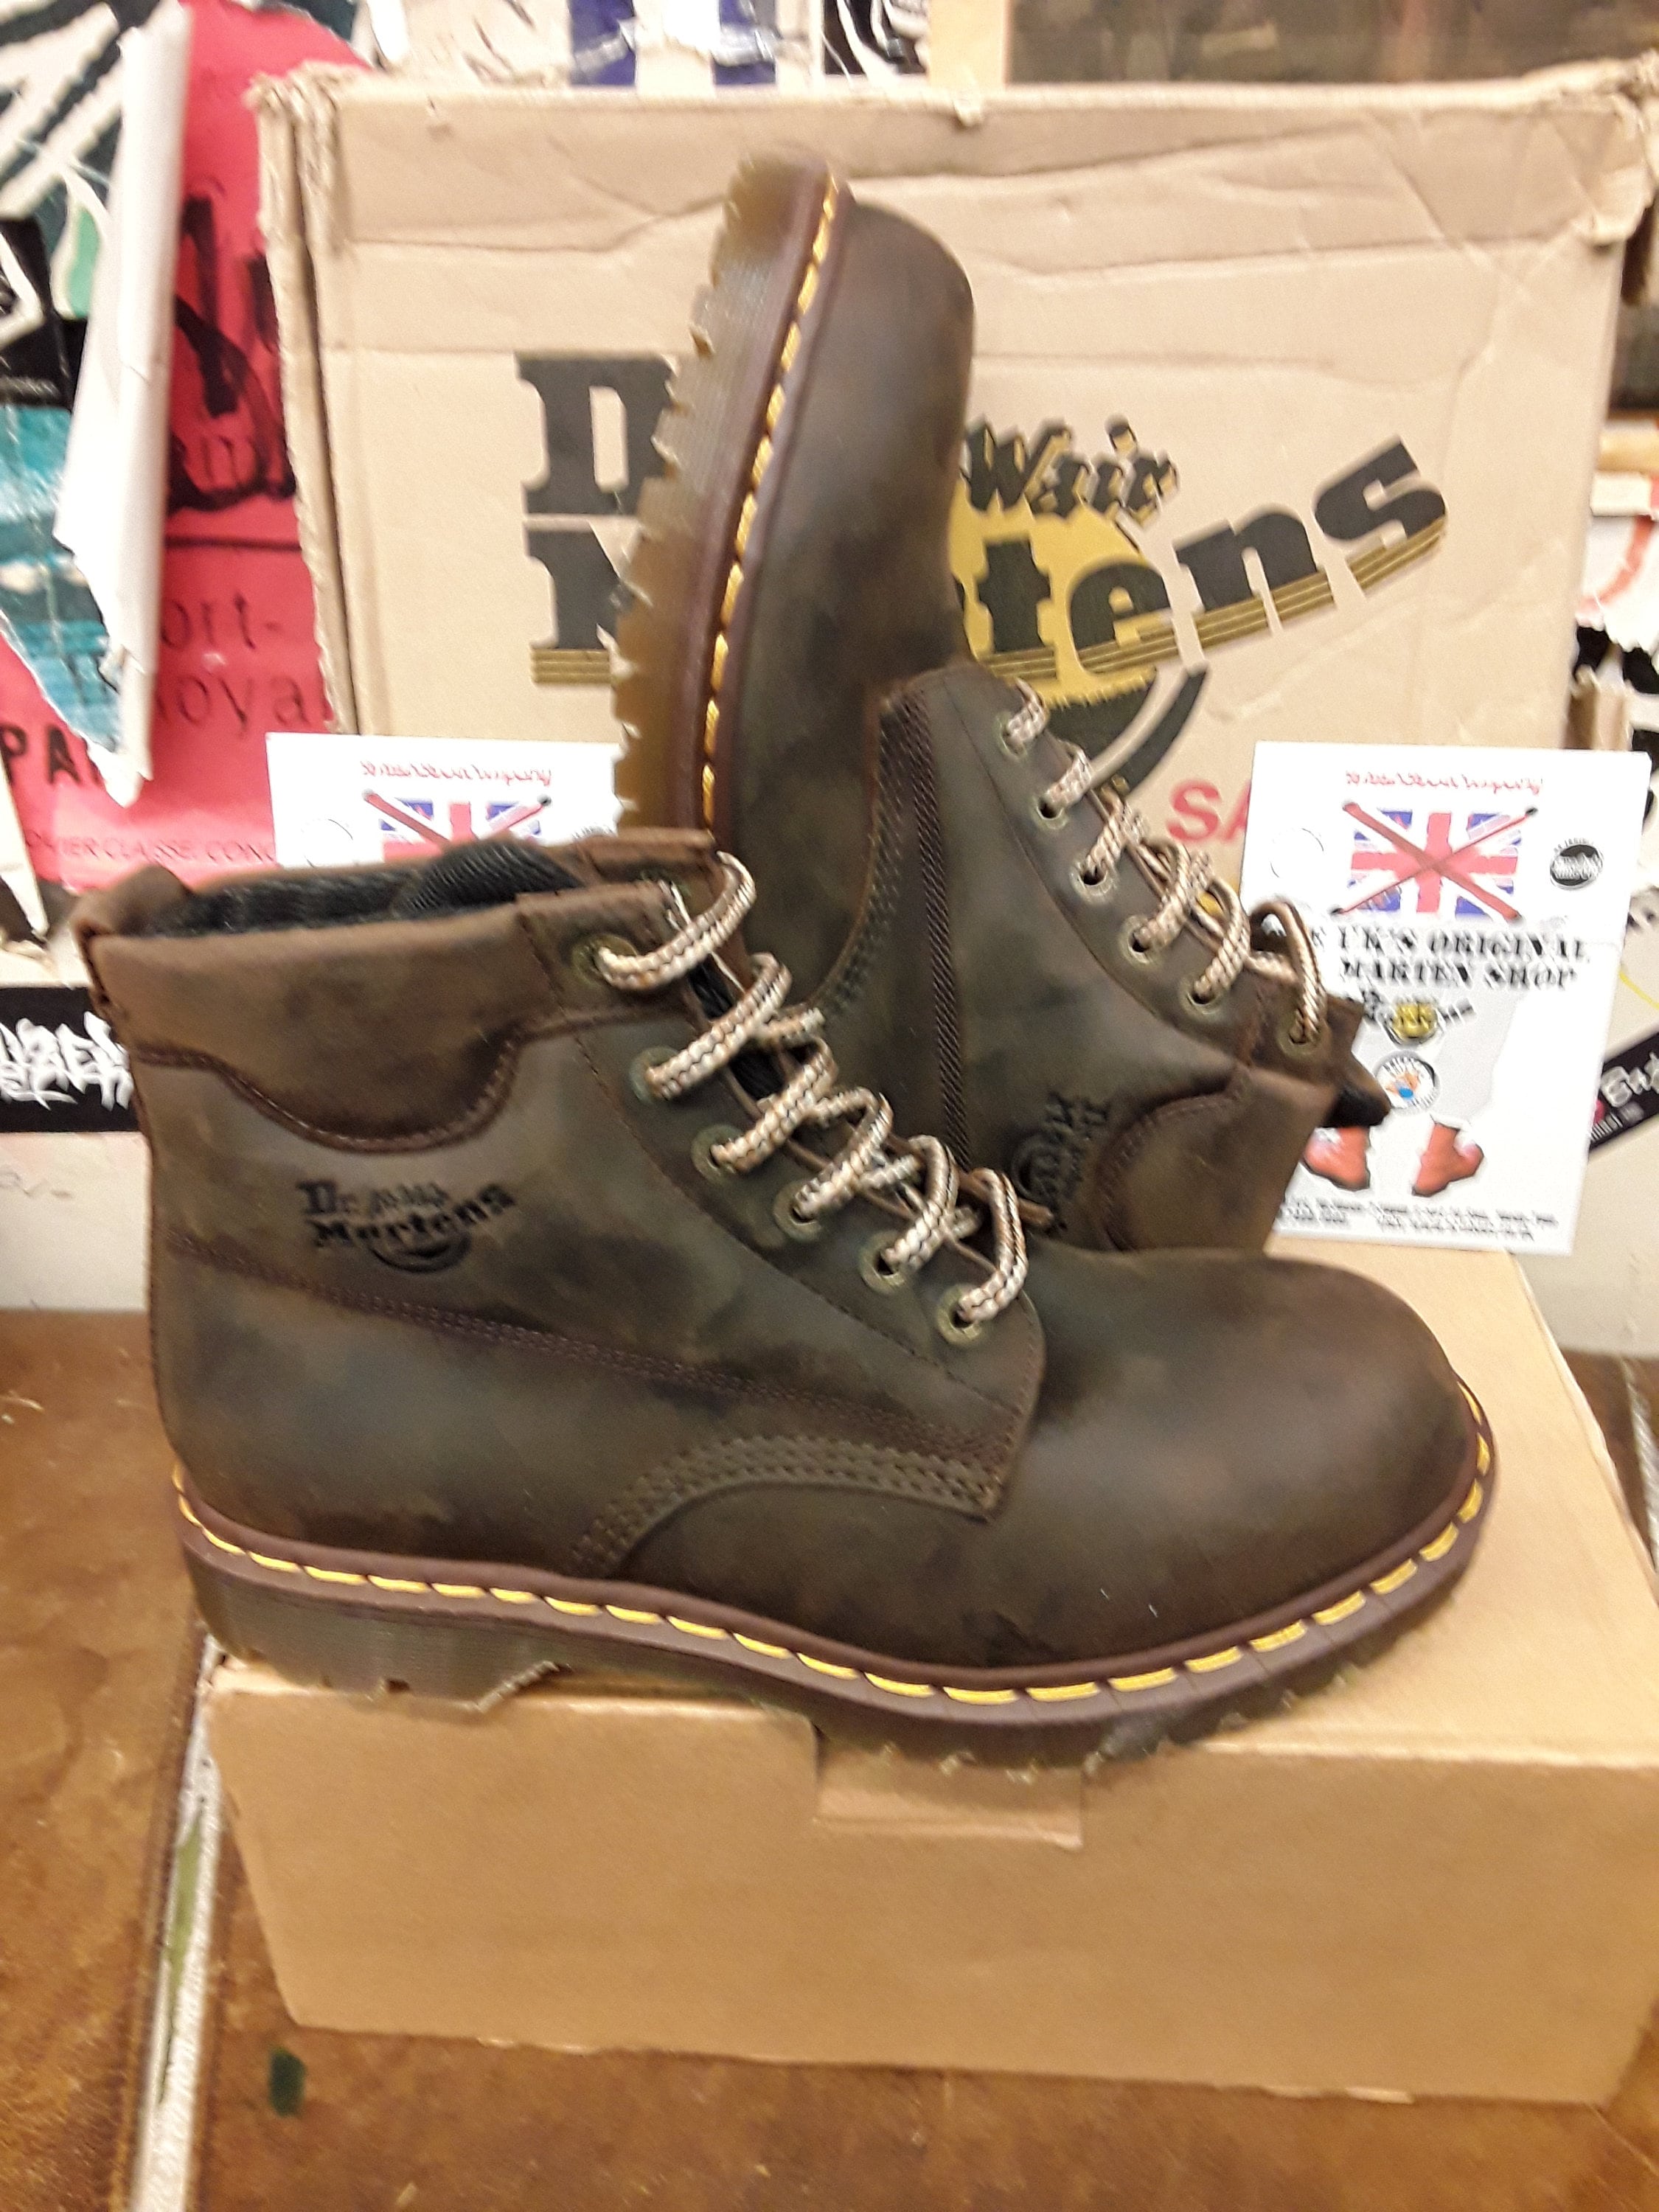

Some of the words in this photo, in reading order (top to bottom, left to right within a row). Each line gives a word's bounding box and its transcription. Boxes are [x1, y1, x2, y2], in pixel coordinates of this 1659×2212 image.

[514, 351, 672, 515] D
[158, 592, 285, 652] ort-
[155, 662, 333, 742] oya
[1427, 928, 1590, 961] ORIGINAL
[1484, 963, 1579, 990] SHOP
